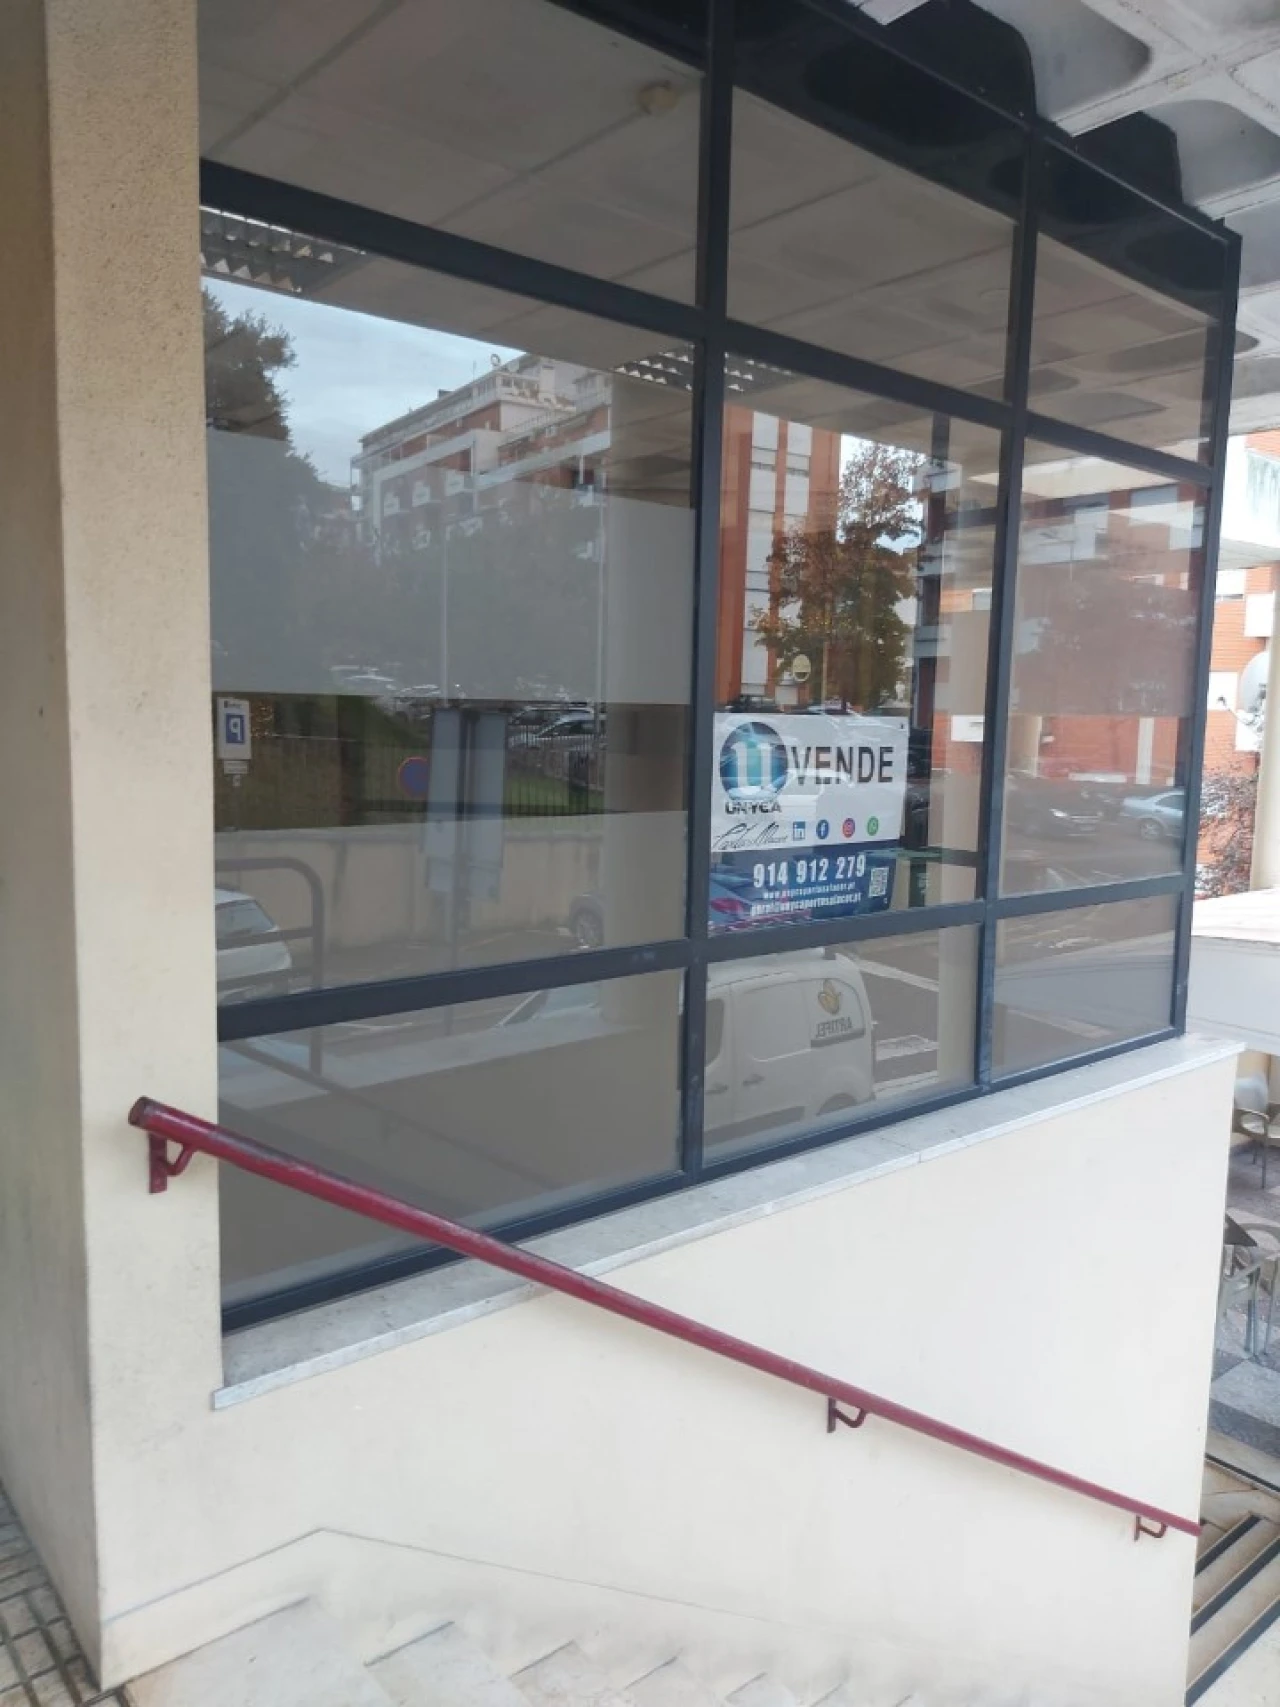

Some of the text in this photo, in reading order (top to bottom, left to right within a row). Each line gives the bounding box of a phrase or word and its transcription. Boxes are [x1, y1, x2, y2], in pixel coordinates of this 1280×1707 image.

[791, 746, 893, 784] VENDE
[753, 854, 866, 888] 914 912 279
